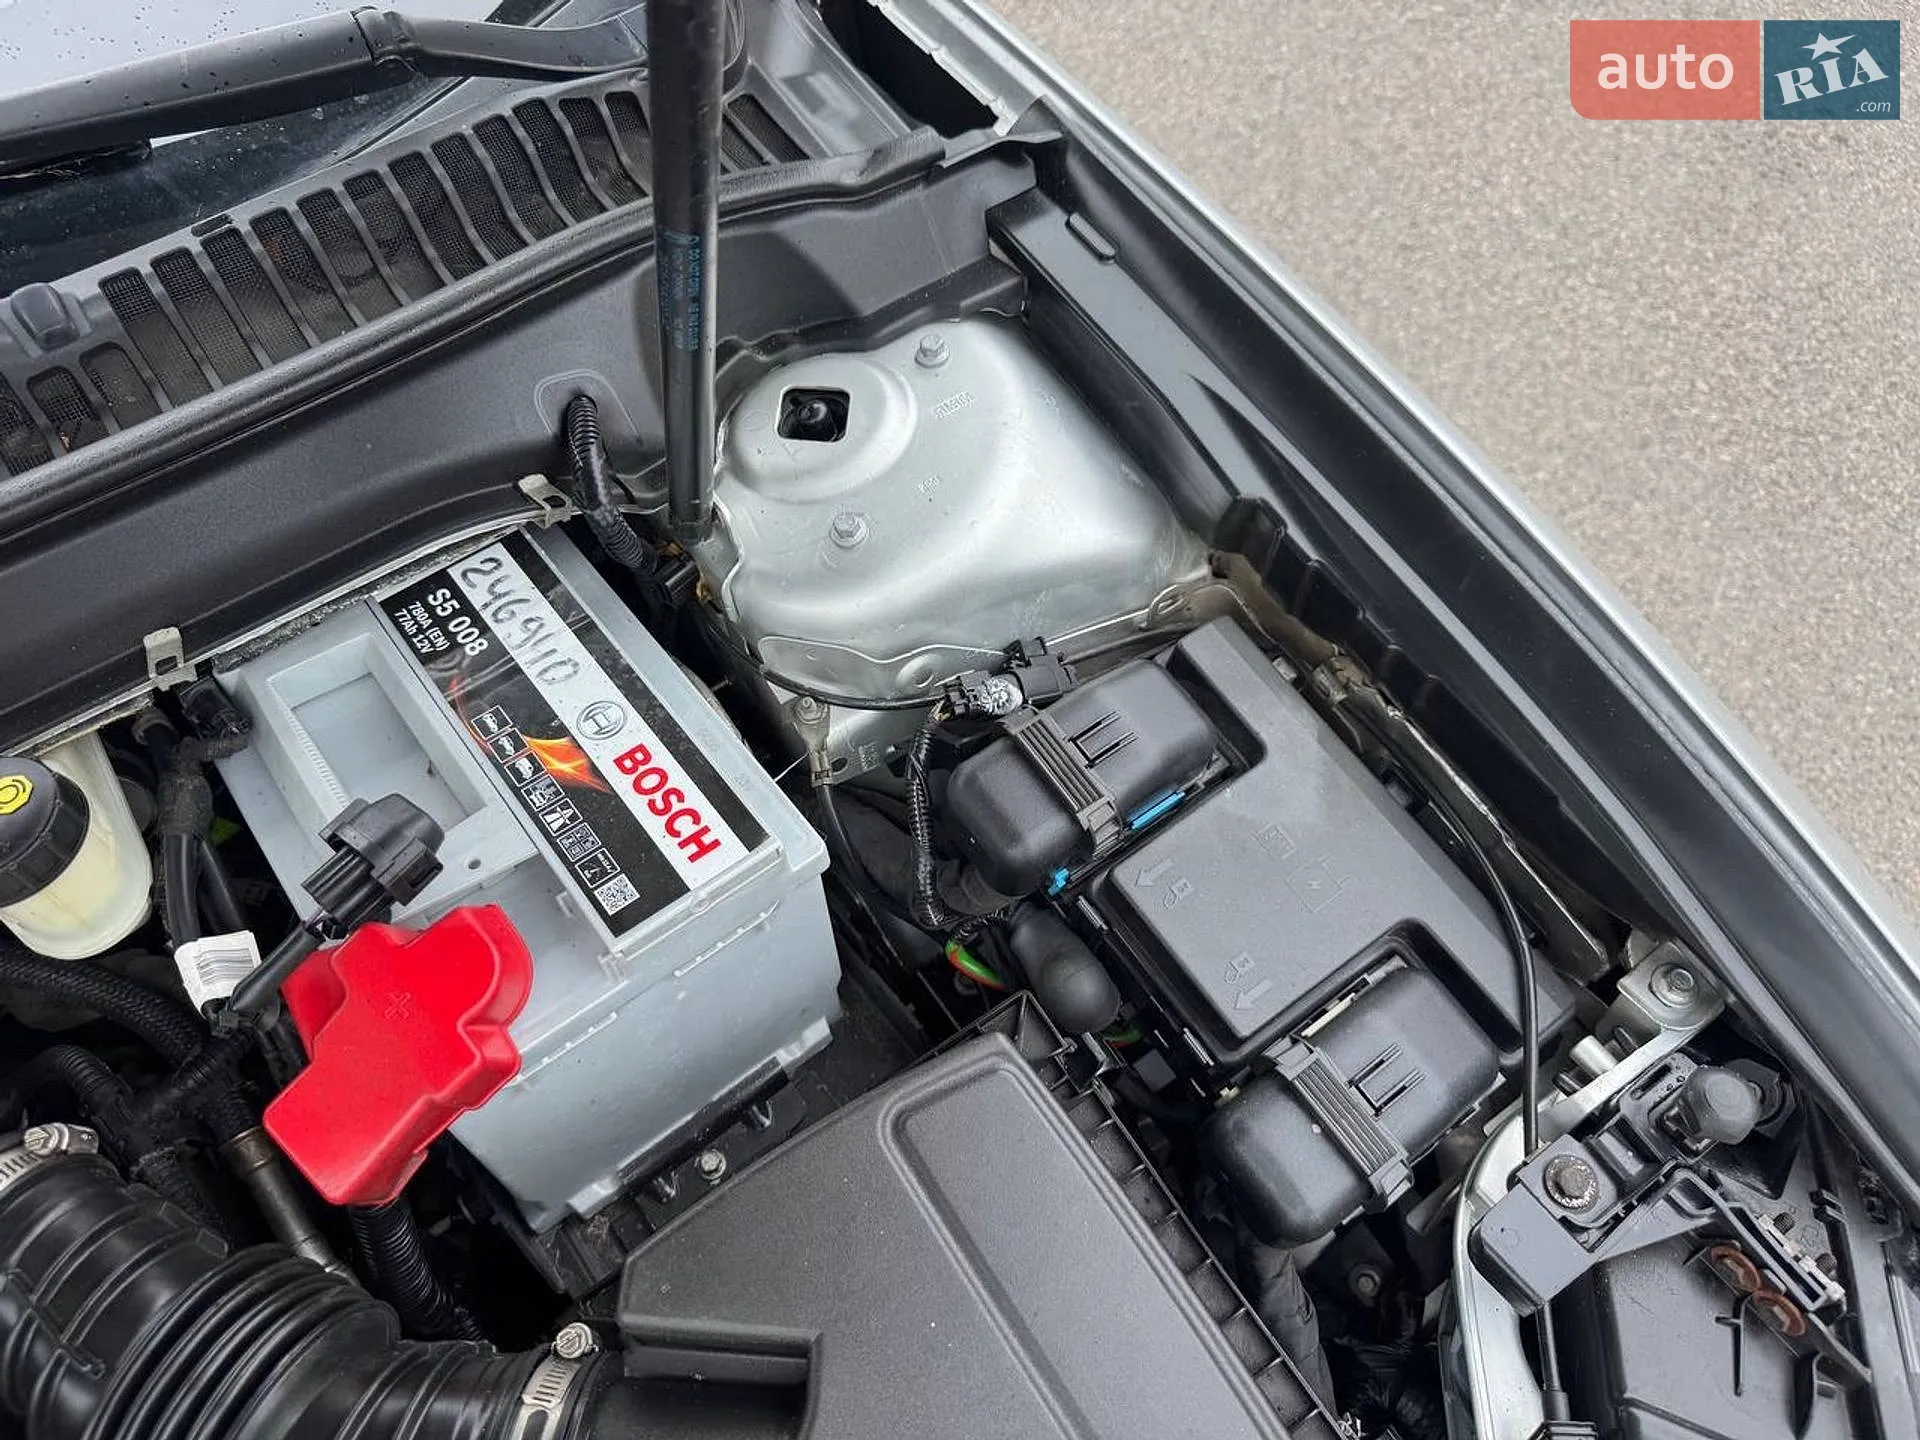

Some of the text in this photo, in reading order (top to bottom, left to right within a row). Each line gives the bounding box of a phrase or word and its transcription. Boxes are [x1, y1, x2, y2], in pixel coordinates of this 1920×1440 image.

[394, 608, 436, 655] 77Ah 12V
[408, 601, 450, 652] 780A (EN)
[428, 588, 489, 656] S5 008
[613, 743, 722, 864] BOSCH
